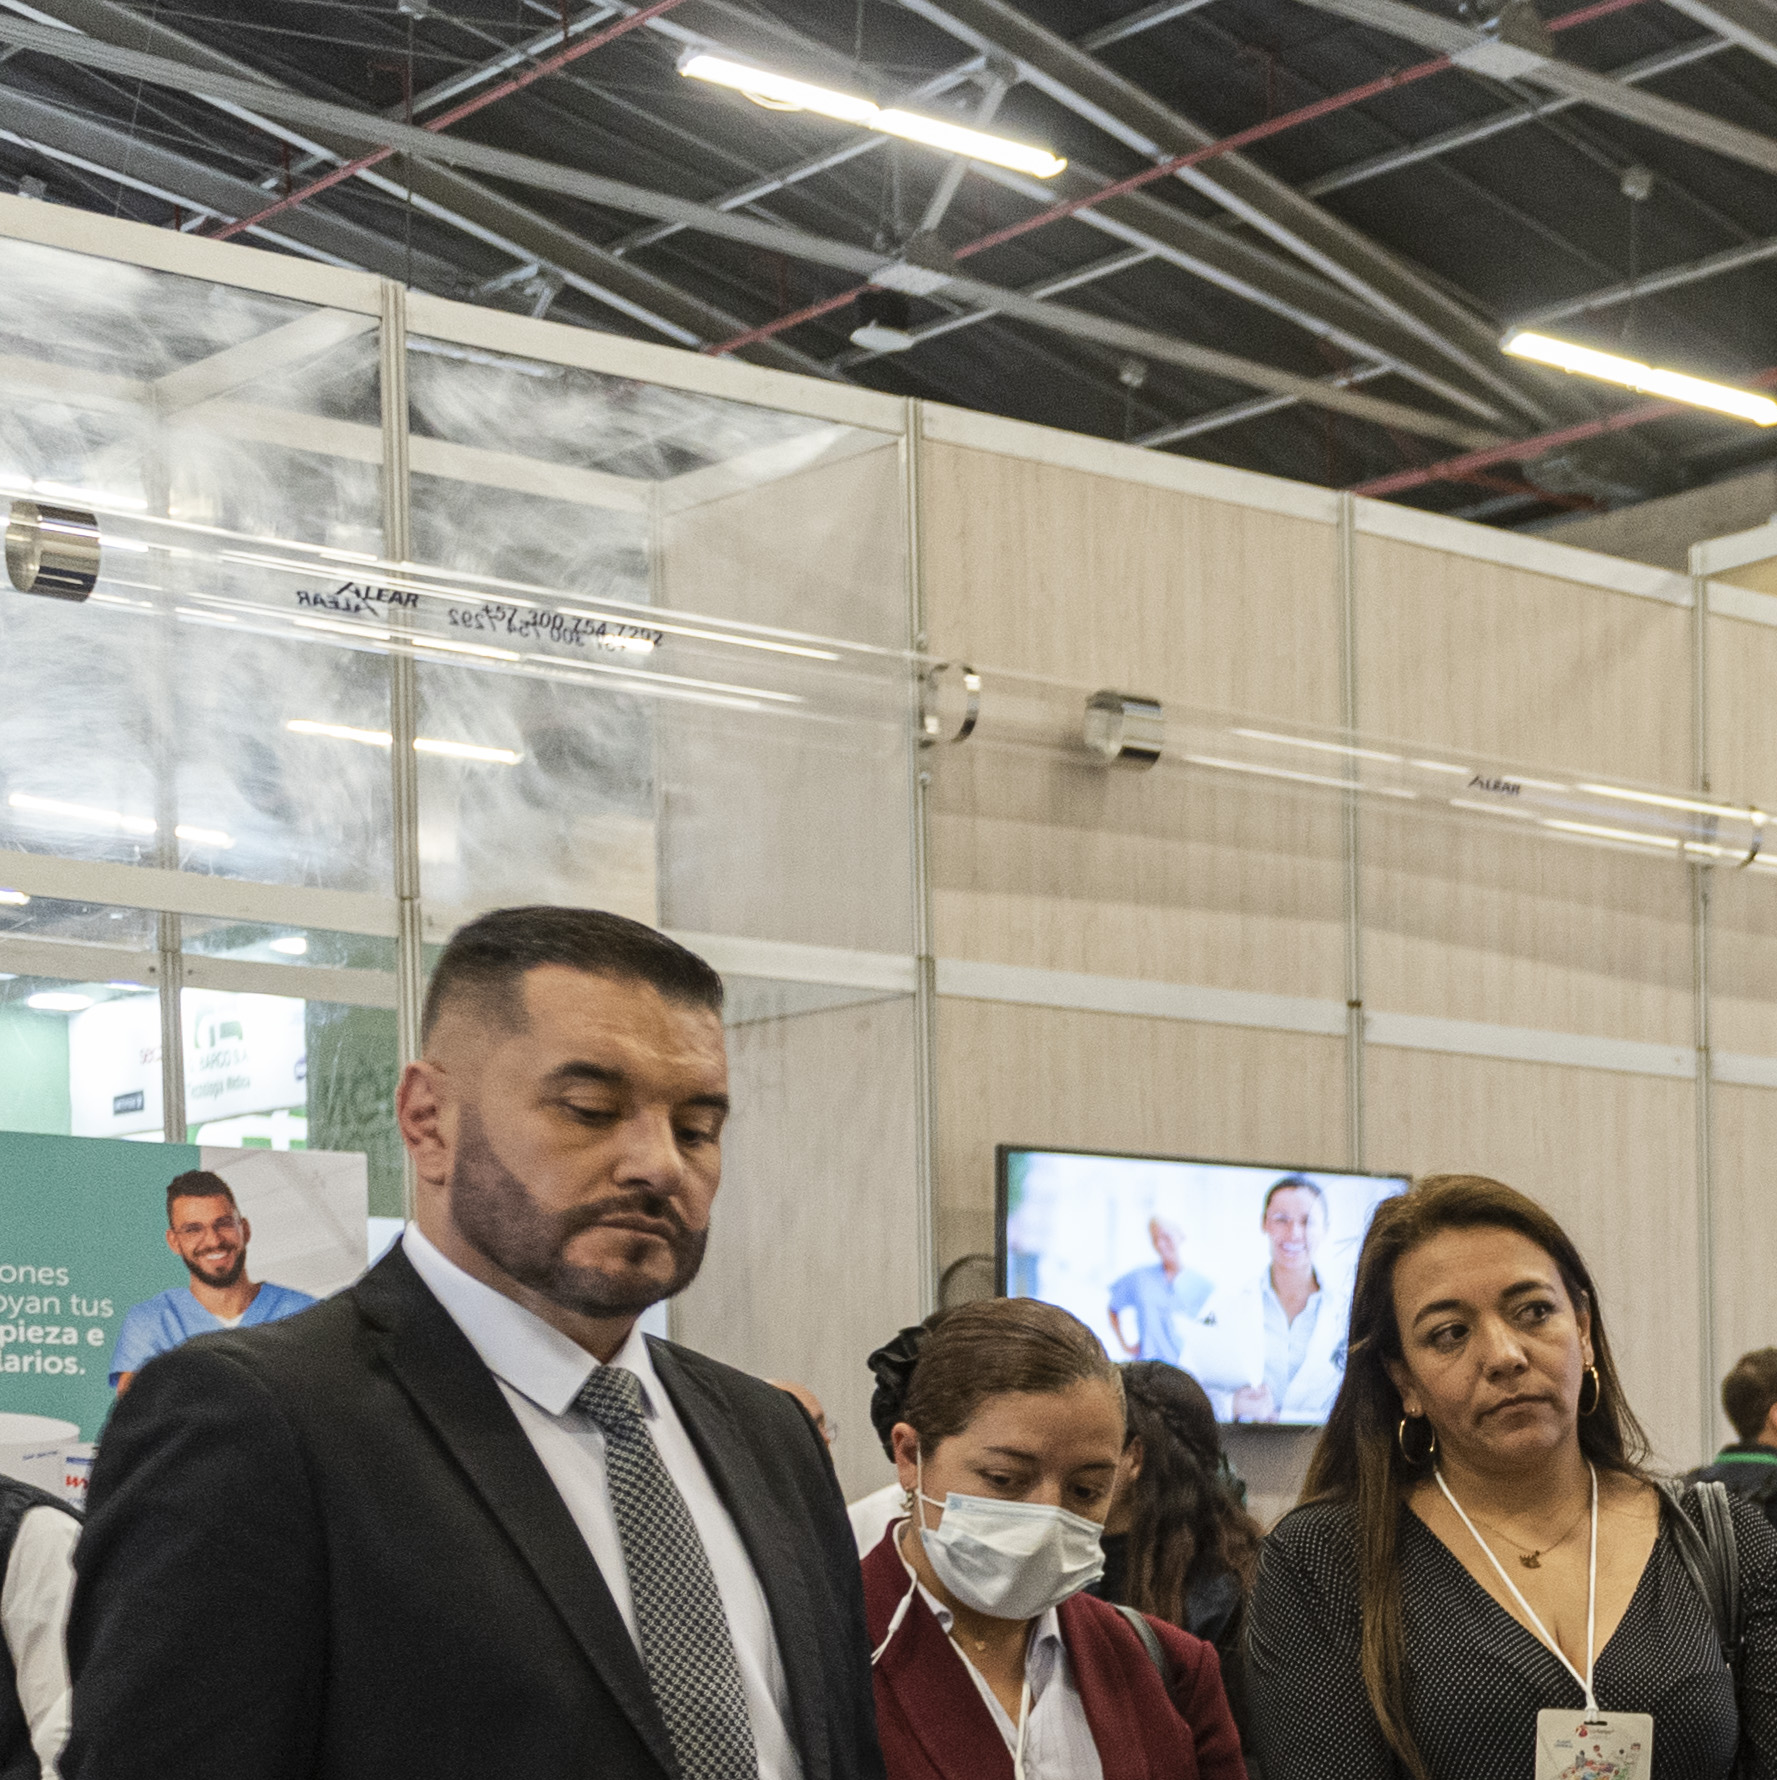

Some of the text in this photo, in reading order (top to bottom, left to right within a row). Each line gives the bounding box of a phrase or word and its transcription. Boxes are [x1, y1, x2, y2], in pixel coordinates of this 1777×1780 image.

[336, 582, 419, 608] ALEAR
[0, 1264, 70, 1287] ones
[70, 1293, 115, 1318] tus
[0, 1319, 105, 1349] pieza e
[0, 1349, 86, 1376] arios.
